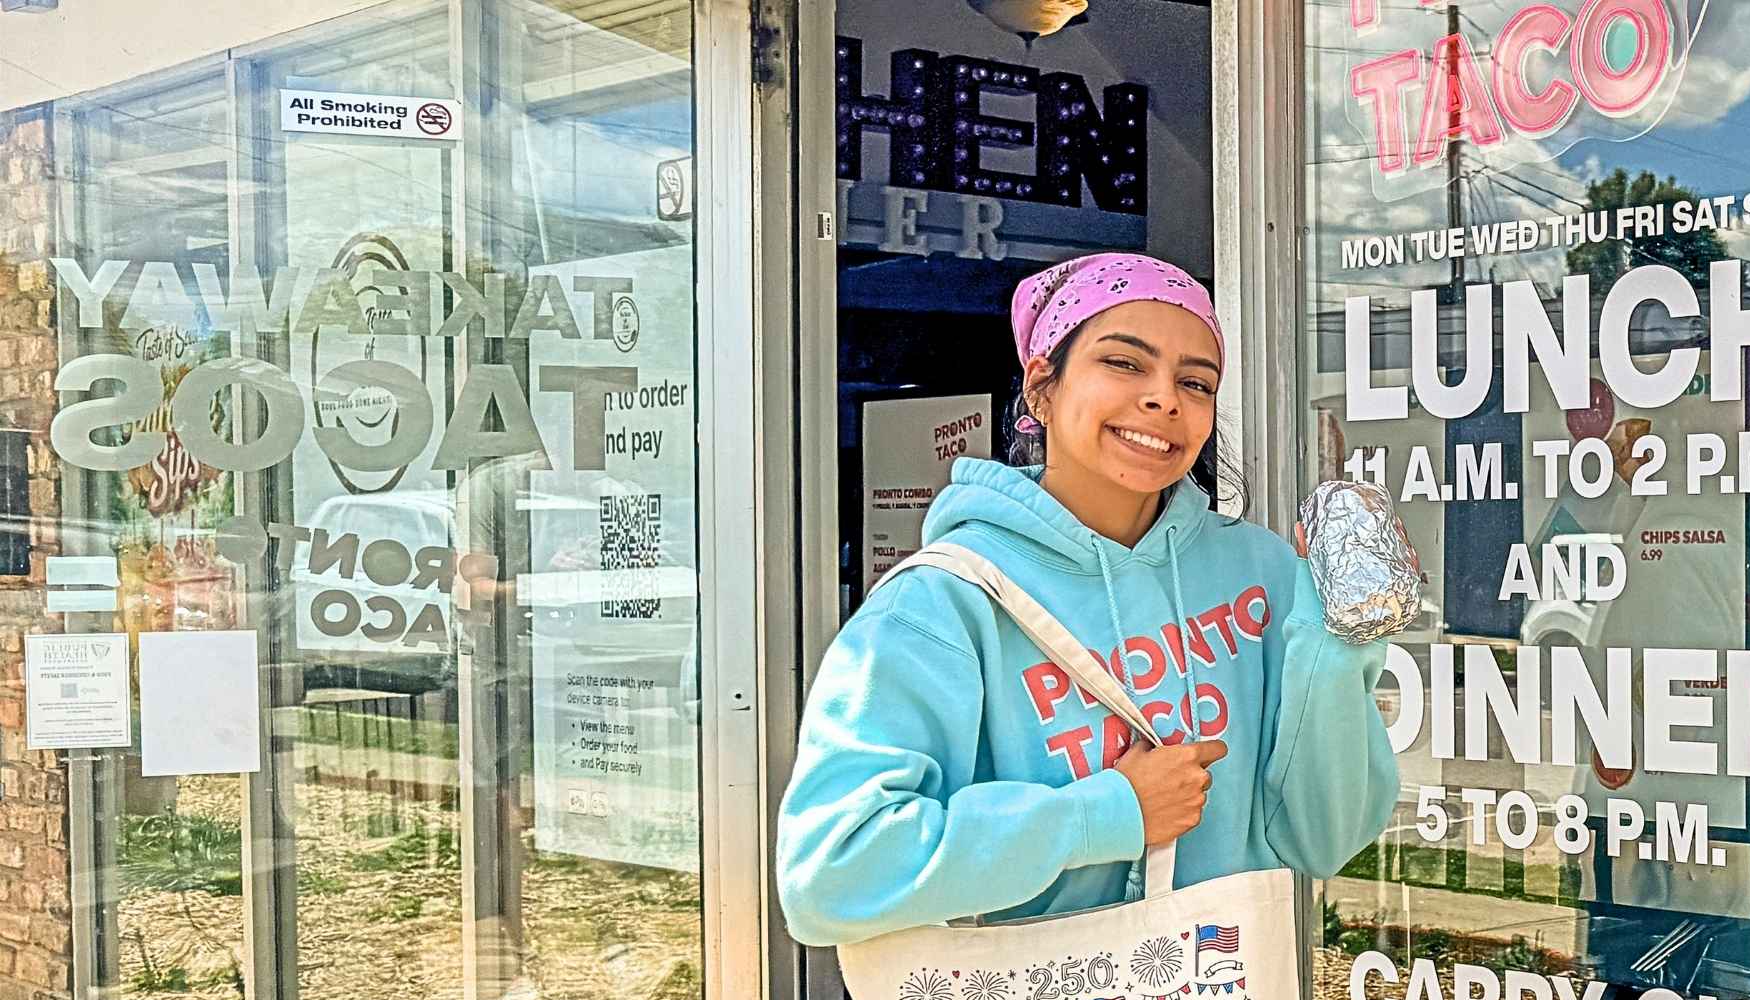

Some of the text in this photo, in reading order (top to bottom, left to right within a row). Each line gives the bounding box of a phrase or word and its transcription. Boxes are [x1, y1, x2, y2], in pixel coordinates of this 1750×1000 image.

[1351, 0, 1672, 174] TACO
[290, 98, 408, 118] All Smoking
[297, 113, 402, 130] Prohibited
[1342, 233, 1402, 268] MON
[1411, 228, 1465, 260] TUE
[1471, 218, 1538, 254] WED
[1545, 211, 1608, 246] THU
[1615, 203, 1663, 240] FRI
[1671, 195, 1736, 232] SAT
[639, 379, 688, 408] order
[934, 412, 982, 443] PRONTO
[632, 430, 663, 460] pay
[935, 438, 967, 461] TACO
[1343, 447, 1386, 485] 11
[1401, 442, 1517, 502] A.M.
[1532, 439, 1614, 499] TO
[1631, 433, 1668, 497] 2
[1640, 530, 1726, 544] CHIPS SALSA
[1640, 549, 1662, 561] 6.99
[1498, 543, 1627, 601] AND
[567, 673, 655, 692] Scan the code with your
[567, 694, 591, 705] device
[580, 720, 635, 736] View the menu
[580, 738, 638, 755] Order your food
[580, 757, 642, 776] and Pay securely
[1415, 785, 1727, 867] 5 TO 8 P.M.
[1030, 956, 1113, 1000] 250
